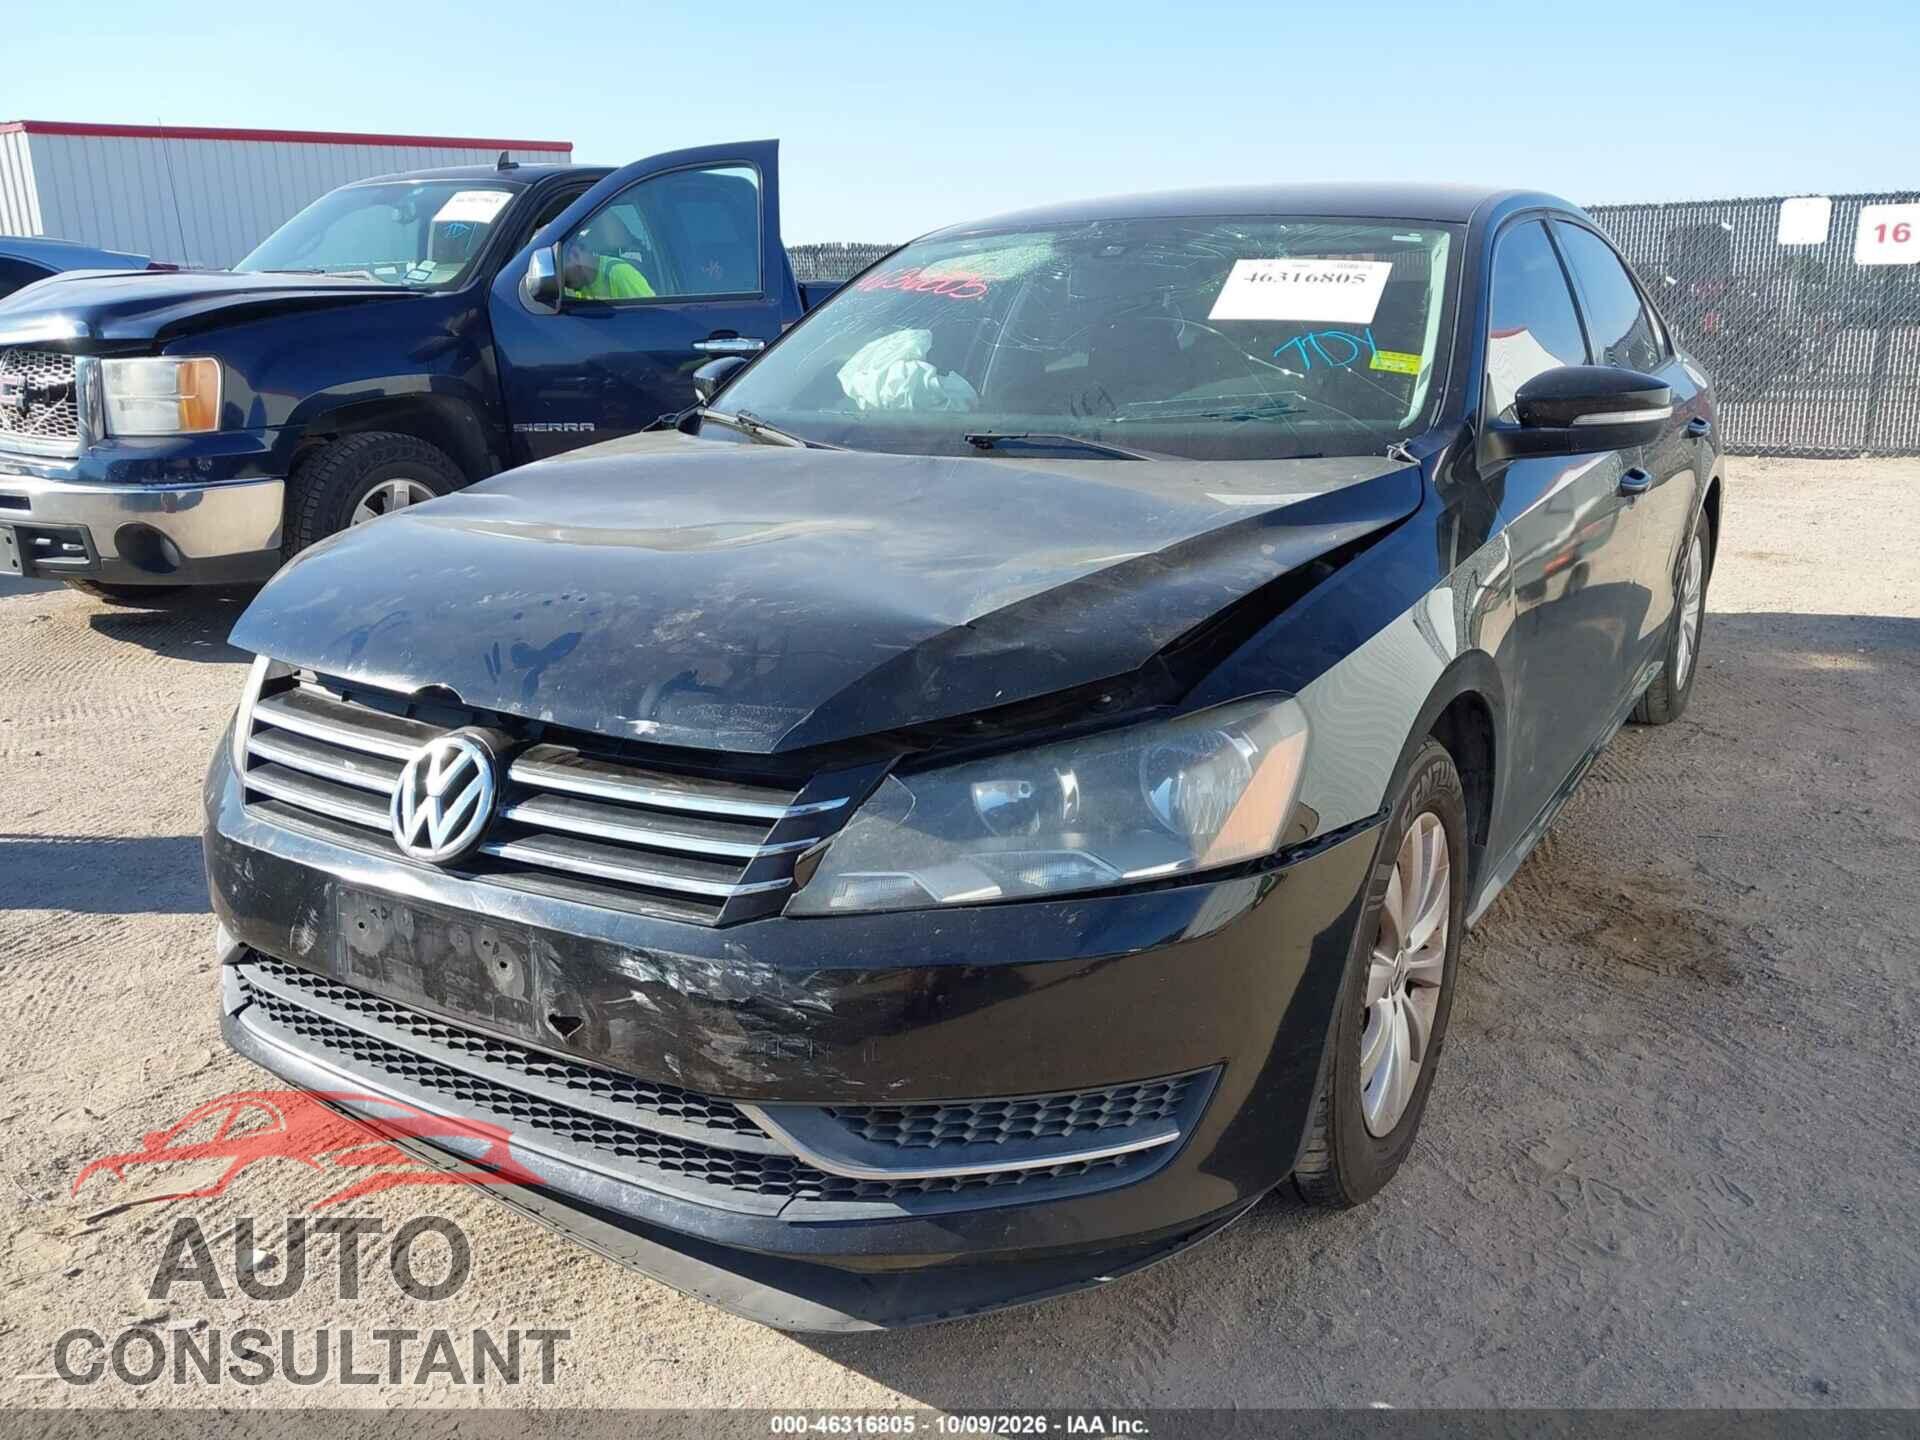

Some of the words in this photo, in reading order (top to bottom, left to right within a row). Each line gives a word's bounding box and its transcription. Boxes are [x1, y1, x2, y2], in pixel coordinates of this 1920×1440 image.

[1874, 222, 1912, 244] 16
[1243, 271, 1368, 285] 46316805
[512, 422, 596, 433] SIERRA
[395, 738, 490, 858] VW
